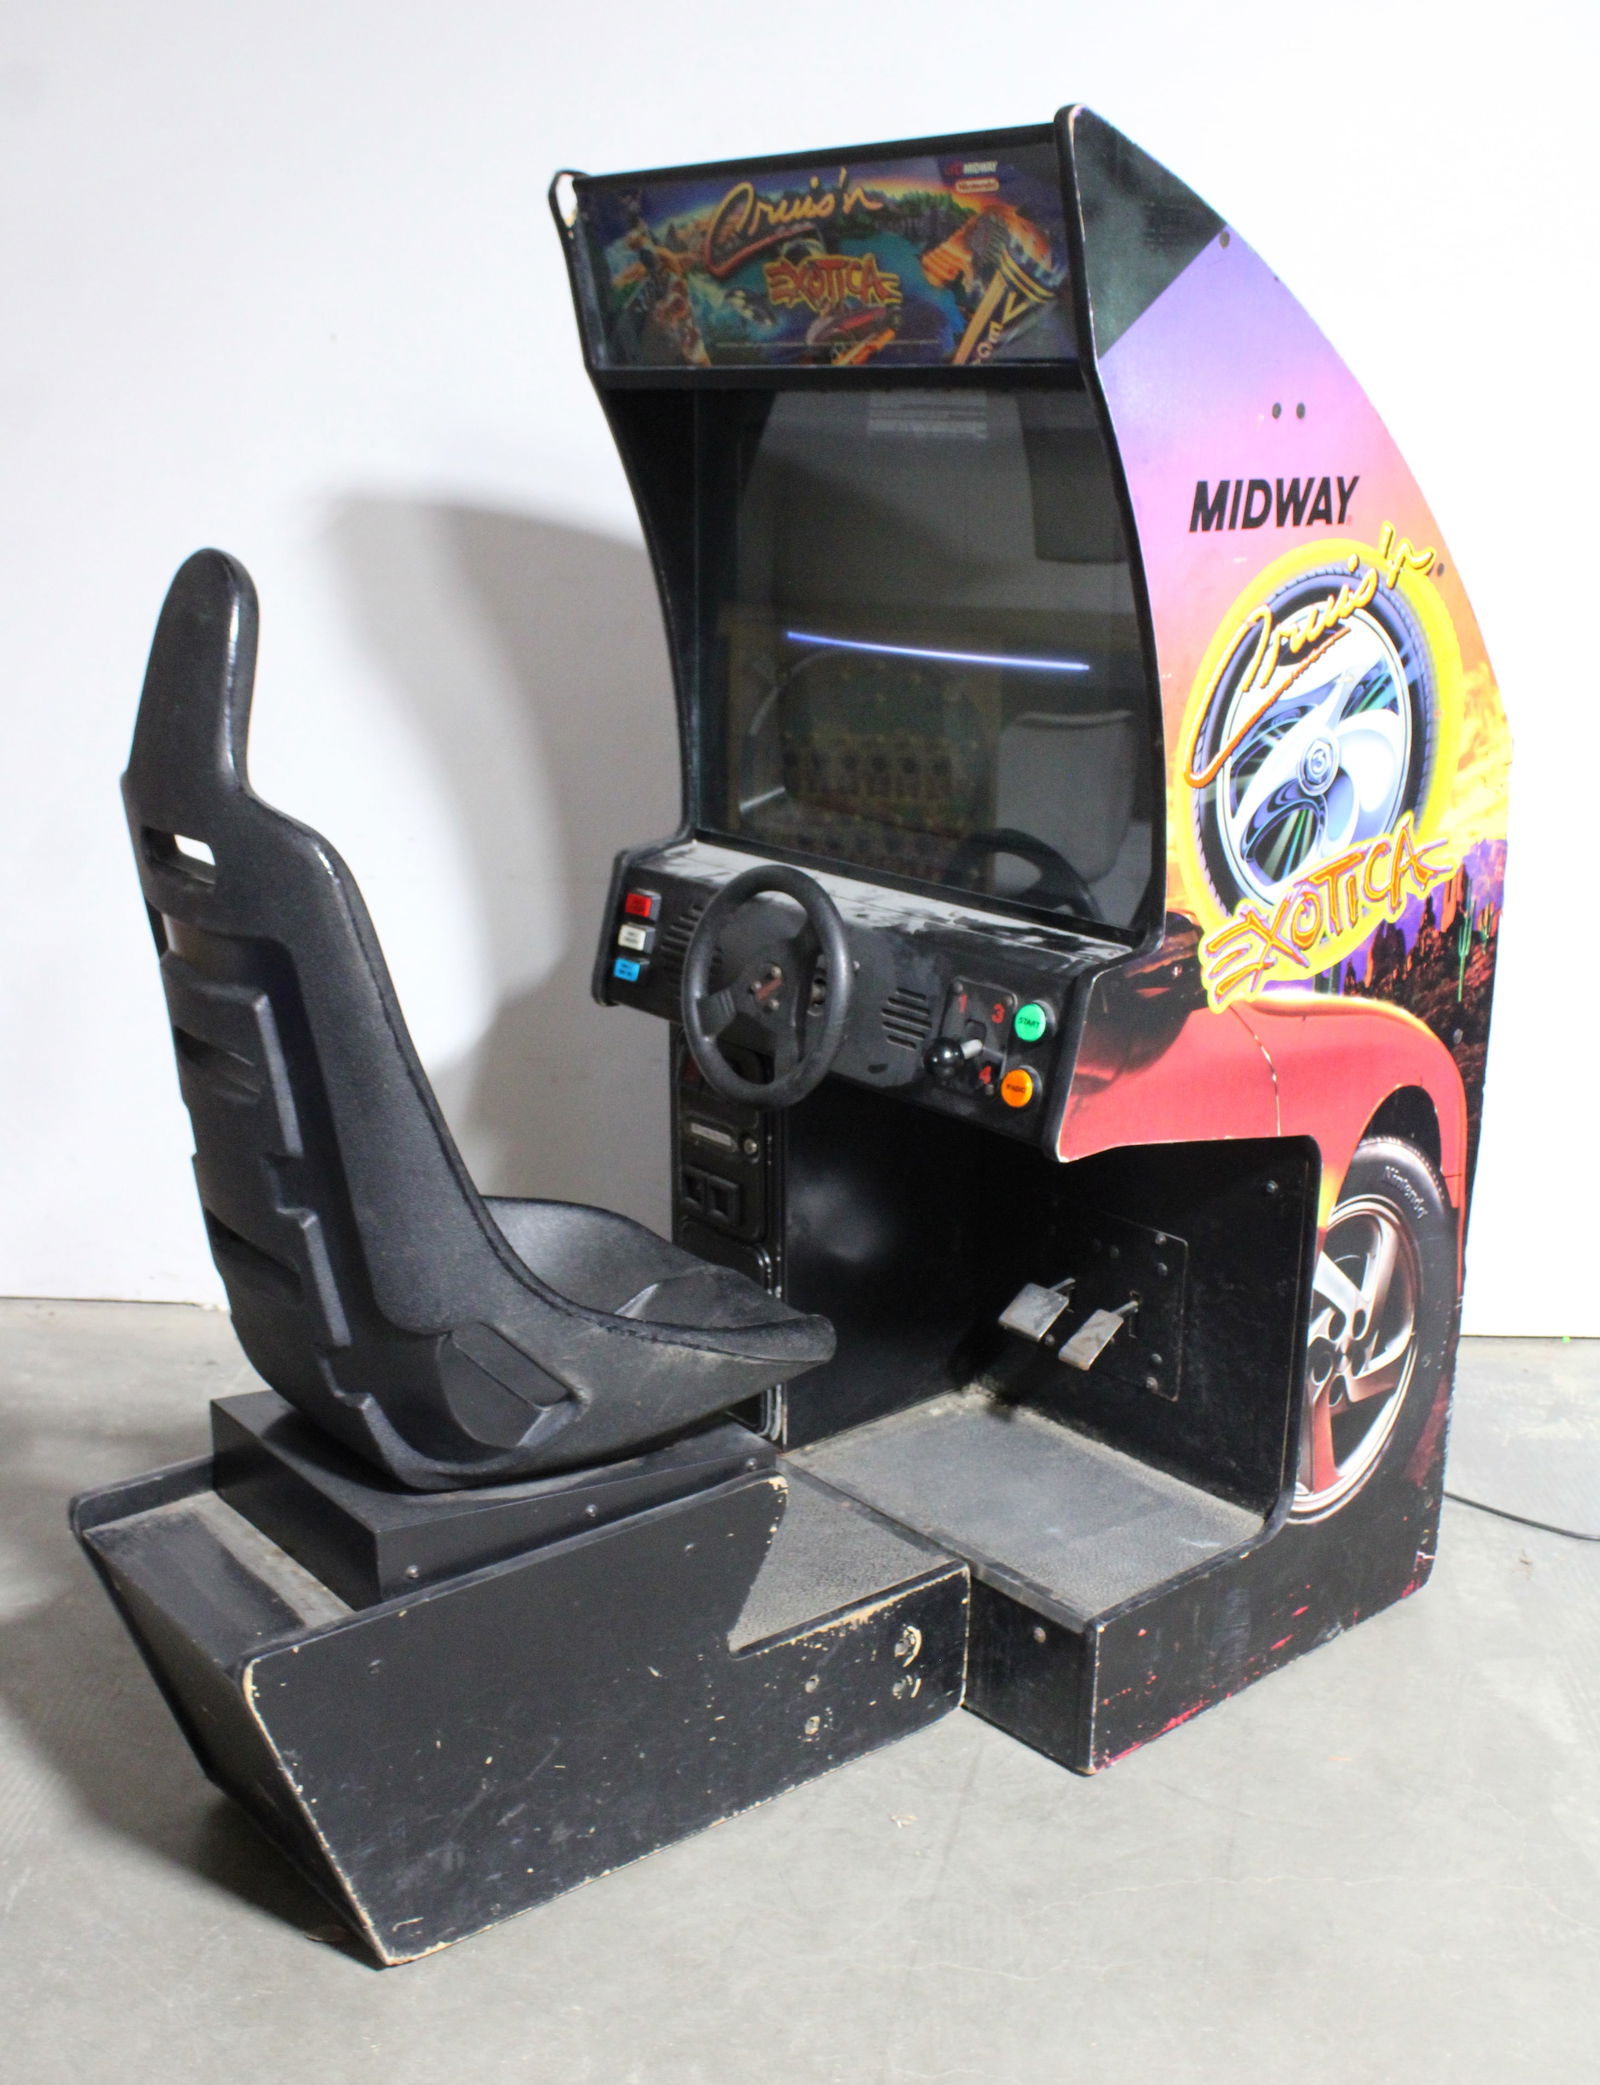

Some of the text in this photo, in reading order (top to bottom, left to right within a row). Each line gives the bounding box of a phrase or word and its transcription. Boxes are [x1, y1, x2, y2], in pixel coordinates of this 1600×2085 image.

[963, 161, 998, 174] MIDWAY
[765, 254, 904, 311] EXOTICA
[1189, 476, 1360, 533] MIDWAY
[1203, 818, 1455, 1002] EXOTICA
[959, 994, 968, 1013] 1
[992, 1003, 1004, 1023] 3
[1018, 1016, 1040, 1029] START
[979, 1065, 991, 1084] 4
[1384, 1165, 1428, 1219] Nintendo
